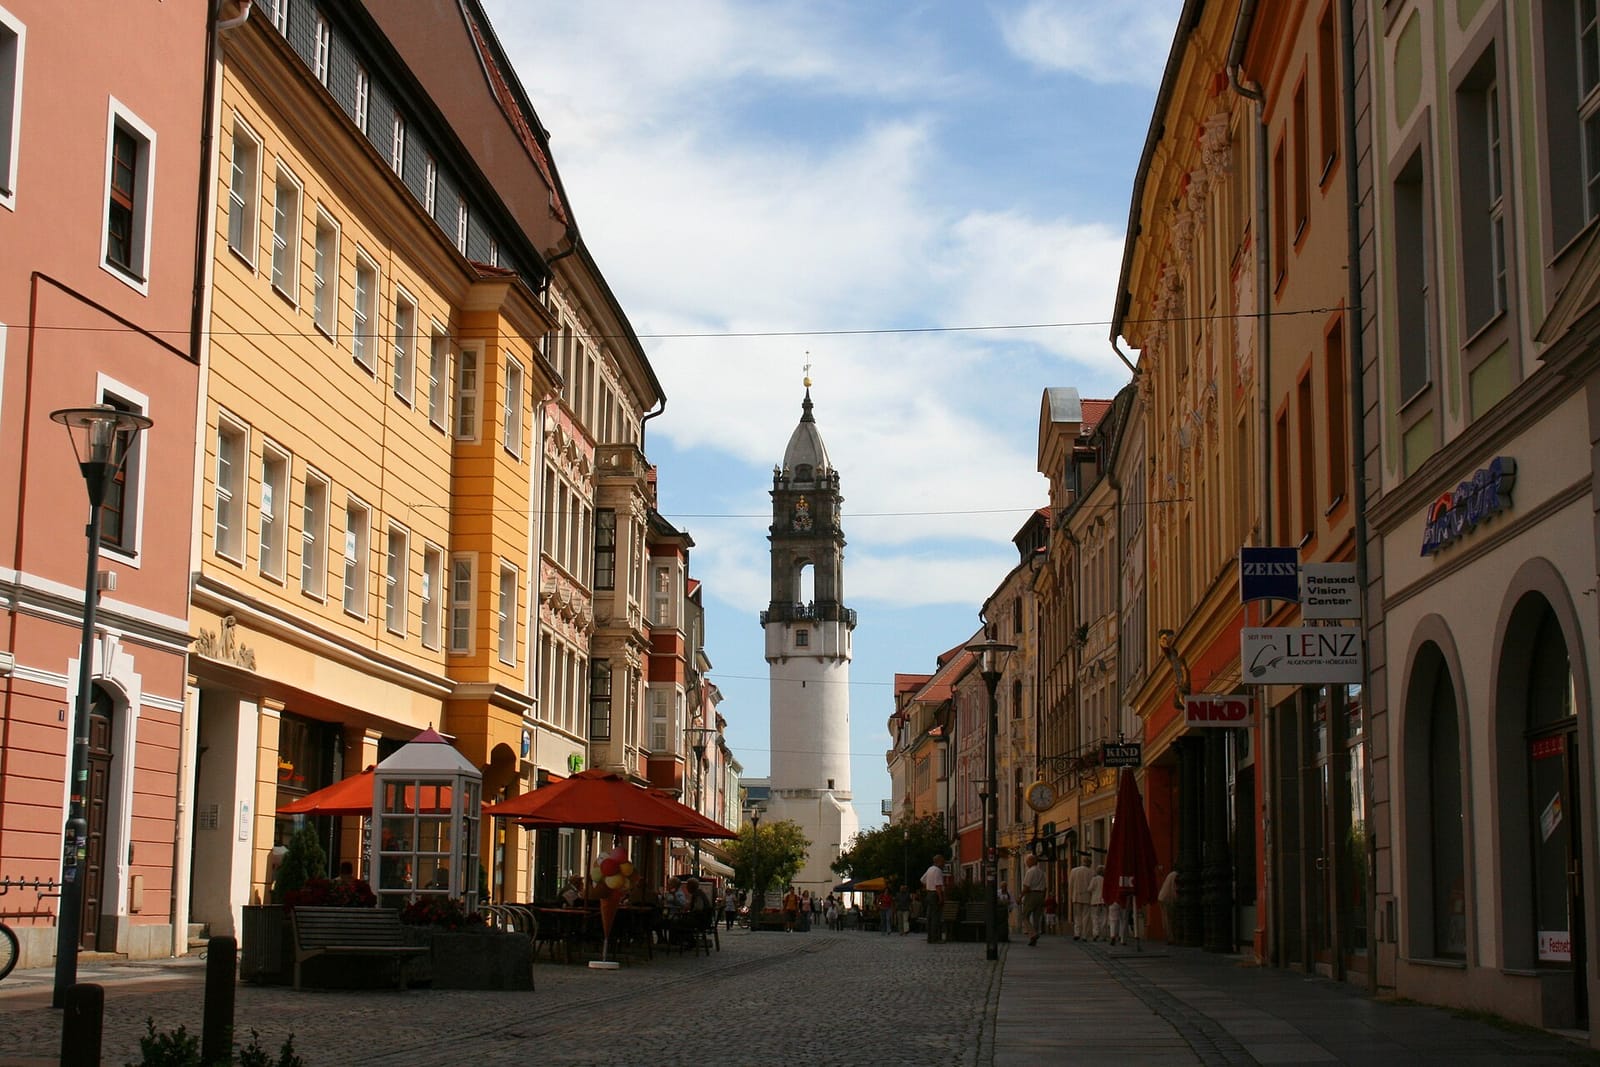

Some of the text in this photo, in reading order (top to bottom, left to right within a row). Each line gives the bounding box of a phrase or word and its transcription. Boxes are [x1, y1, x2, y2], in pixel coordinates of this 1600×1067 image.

[1243, 562, 1296, 576] ZEISS
[1307, 576, 1355, 584] Relaxed
[1308, 587, 1346, 595] Vision
[1308, 597, 1352, 606] Center
[1286, 634, 1358, 657] LENZ
[1188, 701, 1247, 720] NKD
[1106, 748, 1138, 758] KIND
